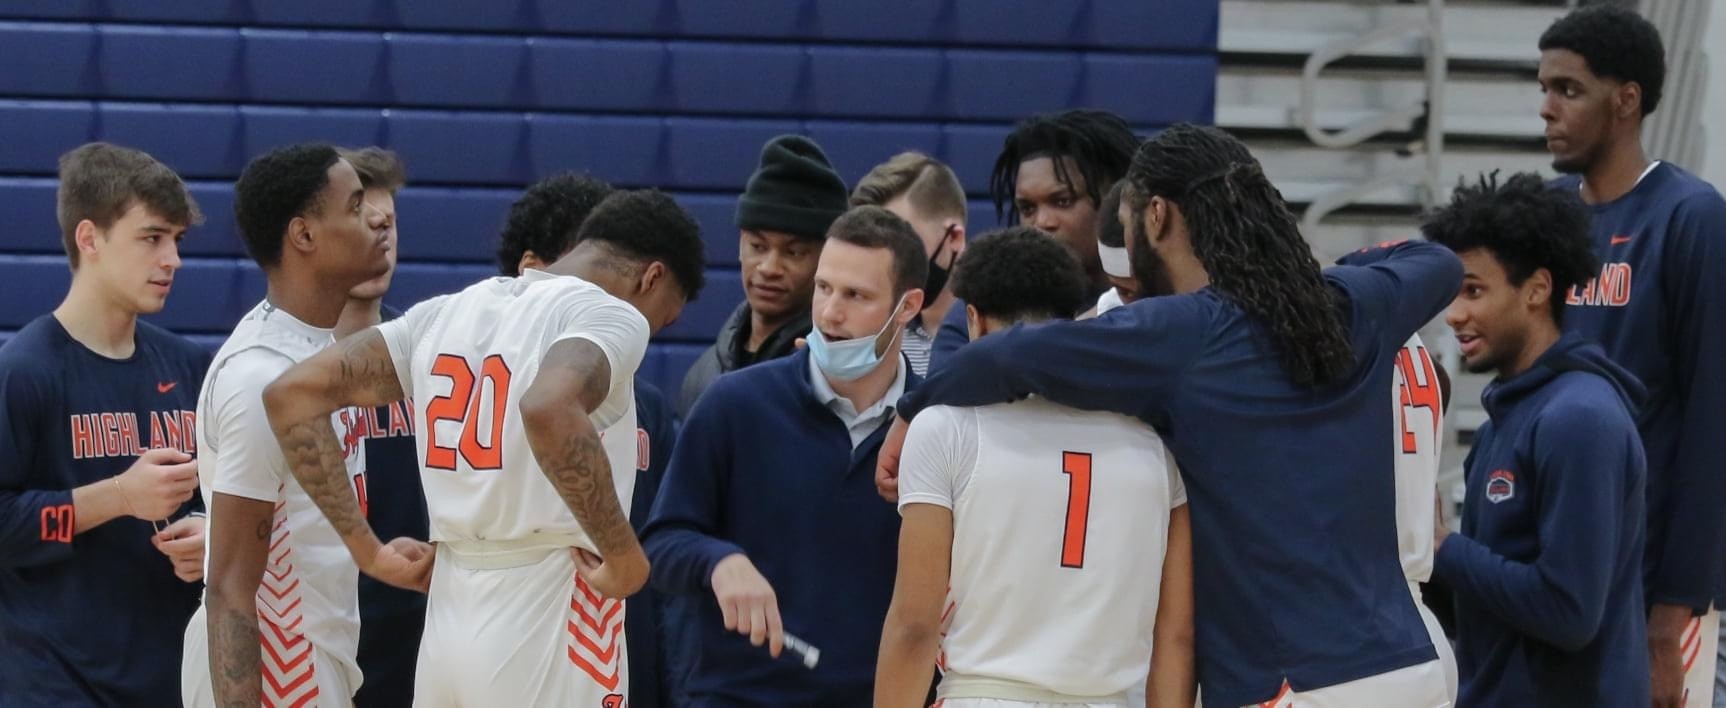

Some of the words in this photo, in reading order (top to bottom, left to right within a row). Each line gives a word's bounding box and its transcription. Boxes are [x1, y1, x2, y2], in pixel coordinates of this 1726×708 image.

[70, 410, 195, 459] HIGHLAND
[425, 353, 512, 471] 20
[1061, 450, 1092, 569] 1
